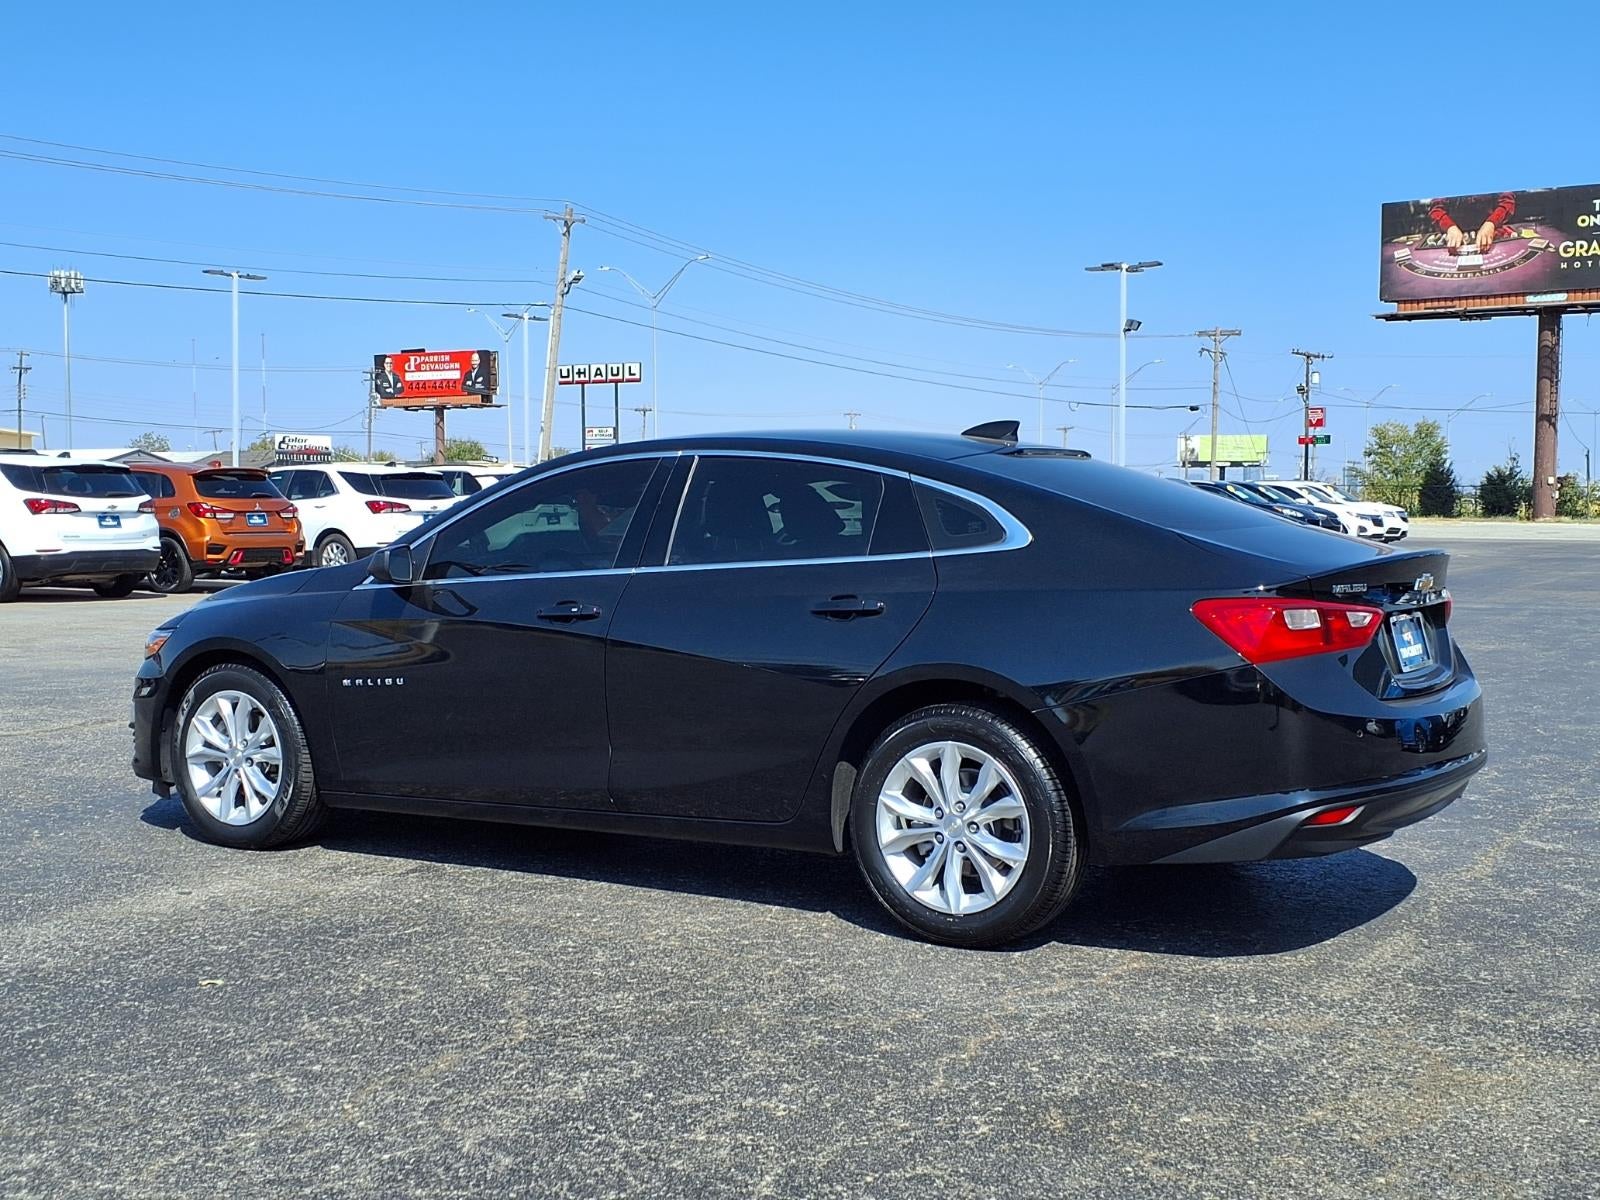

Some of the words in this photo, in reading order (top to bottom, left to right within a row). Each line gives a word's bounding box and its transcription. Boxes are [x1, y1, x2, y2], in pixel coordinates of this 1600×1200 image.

[420, 354, 450, 363] PARRISH
[407, 380, 457, 391] 444-4444
[1331, 583, 1368, 594] MALIBU
[342, 677, 404, 687] MALIBU
